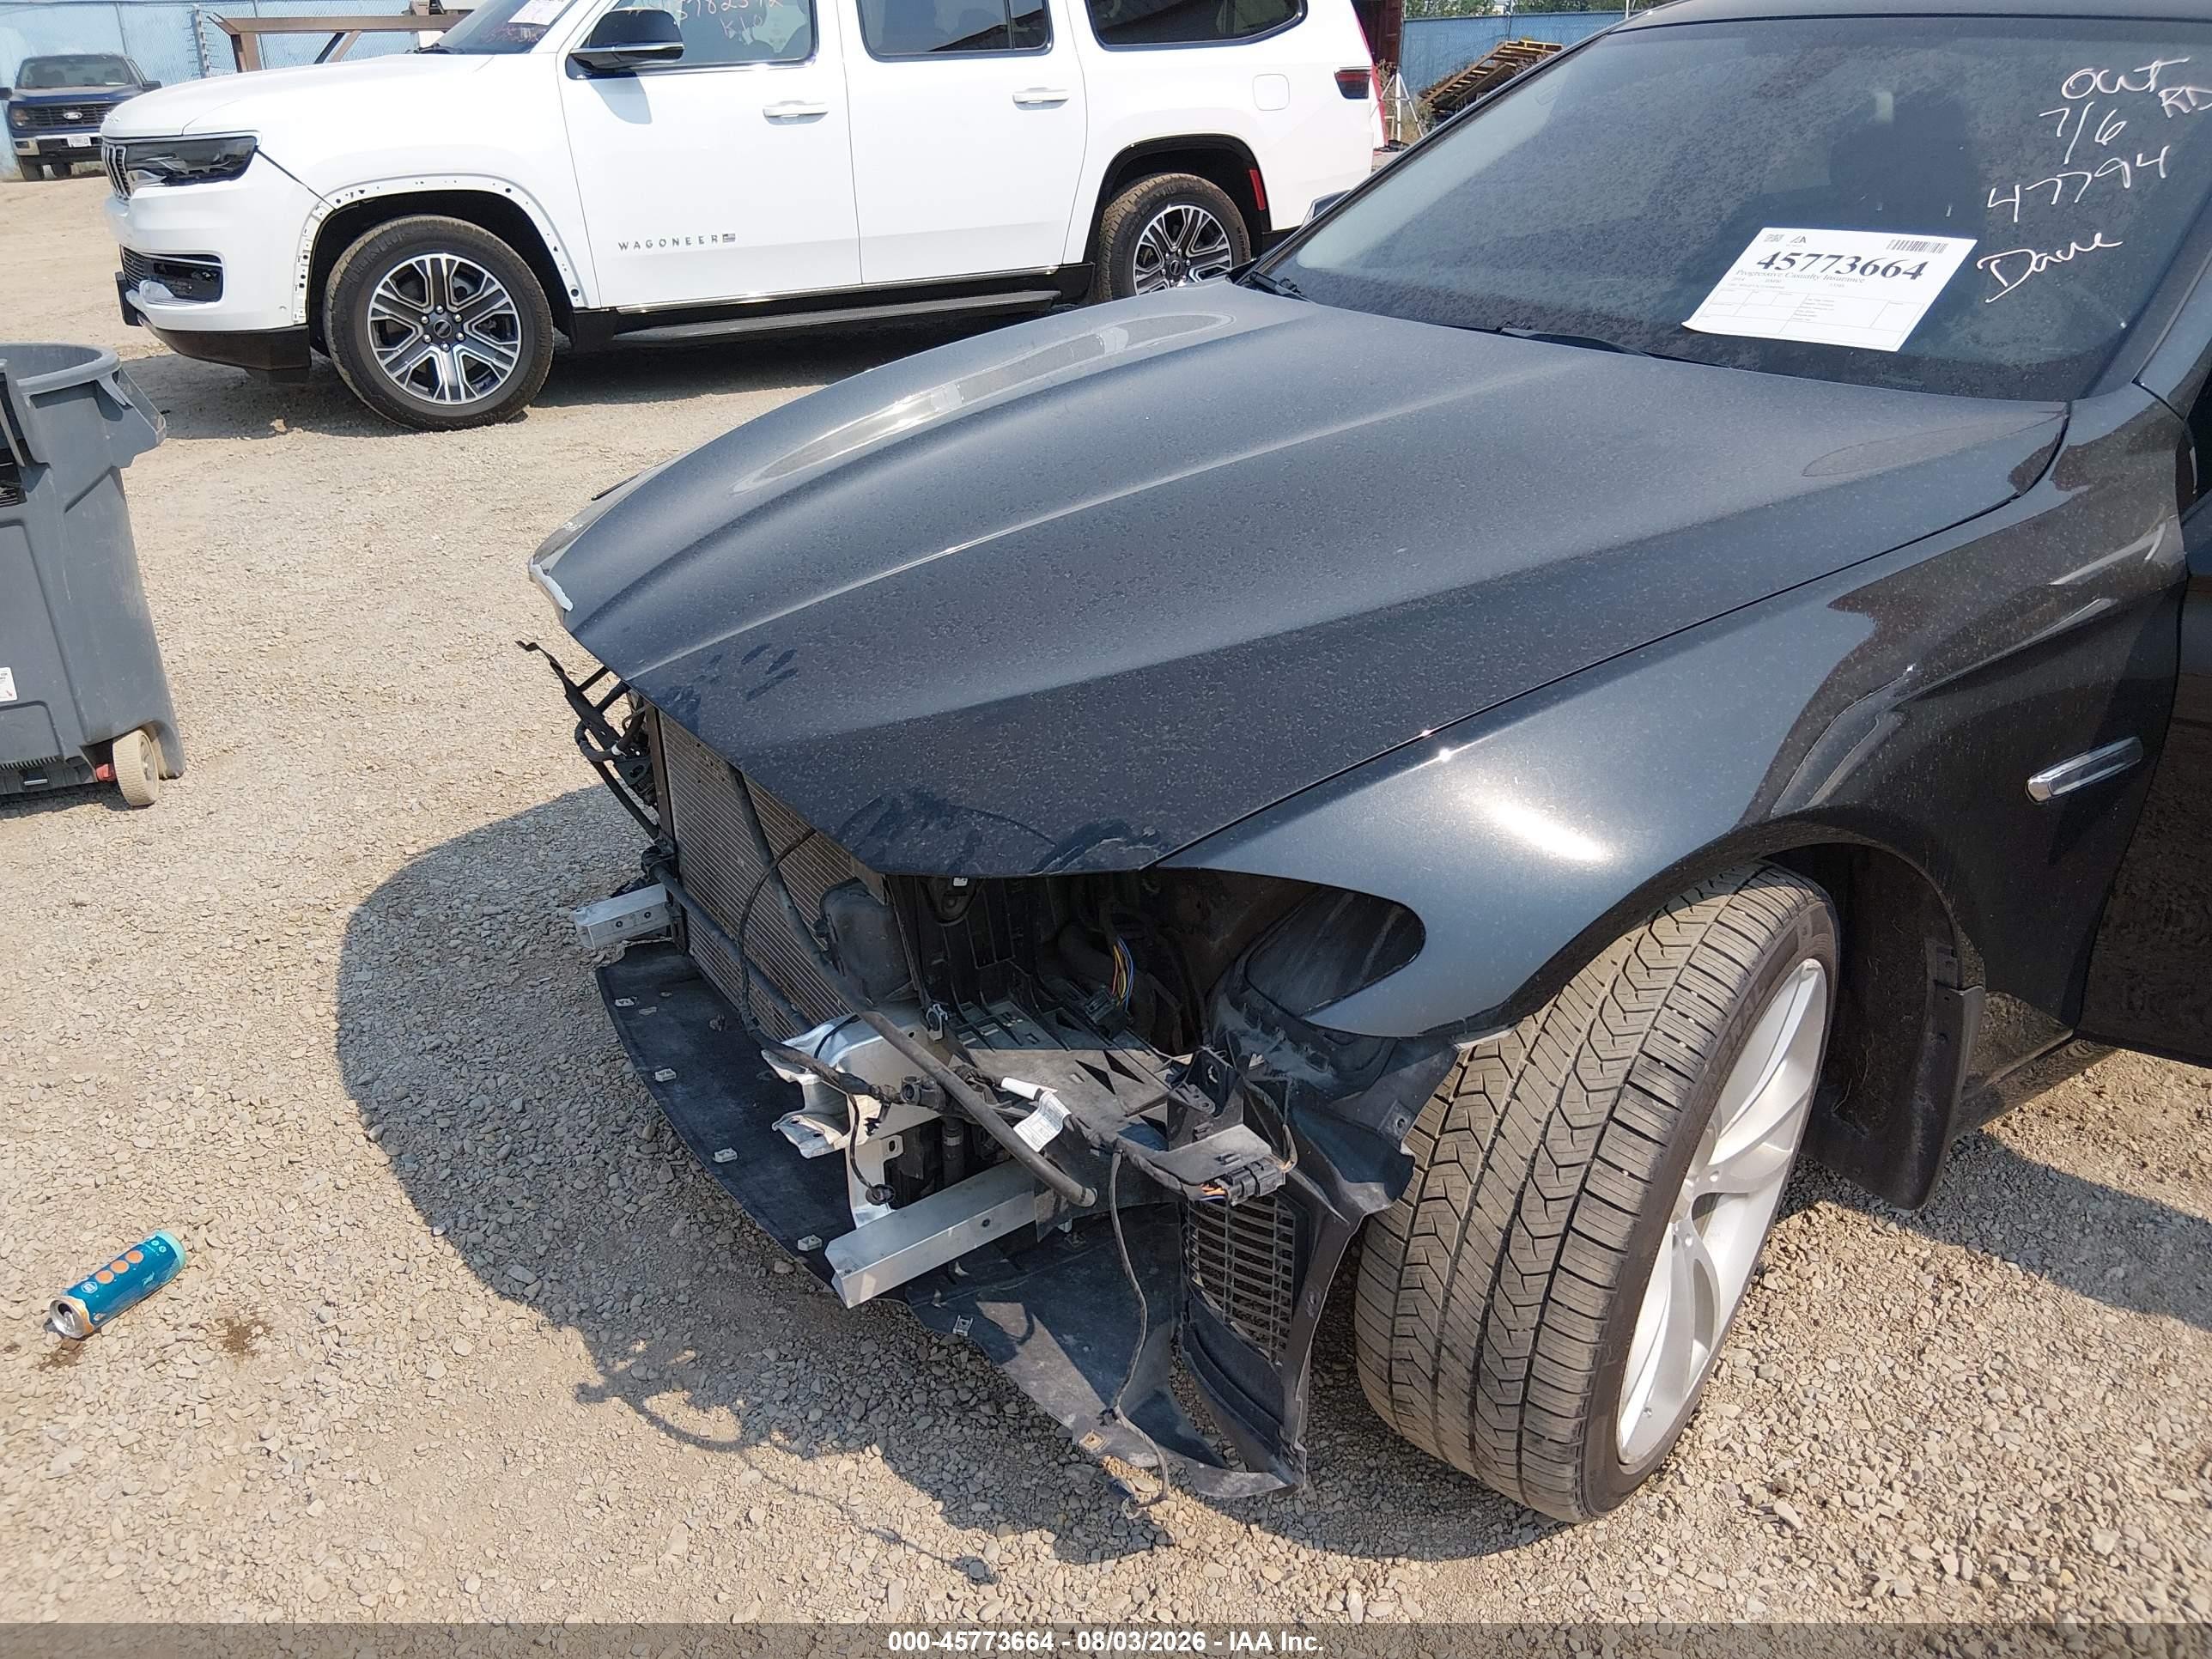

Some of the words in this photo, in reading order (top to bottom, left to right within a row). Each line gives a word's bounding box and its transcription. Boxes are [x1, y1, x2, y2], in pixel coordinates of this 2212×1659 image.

[2039, 101, 2126, 164] 7/6
[1987, 145, 2170, 222] 47794
[618, 234, 718, 251] WAGONEER
[1735, 270, 1783, 278] Progressive
[1784, 271, 1820, 281] Casualty
[1822, 274, 1865, 283] Insurance
[1757, 251, 1929, 280] 45773664
